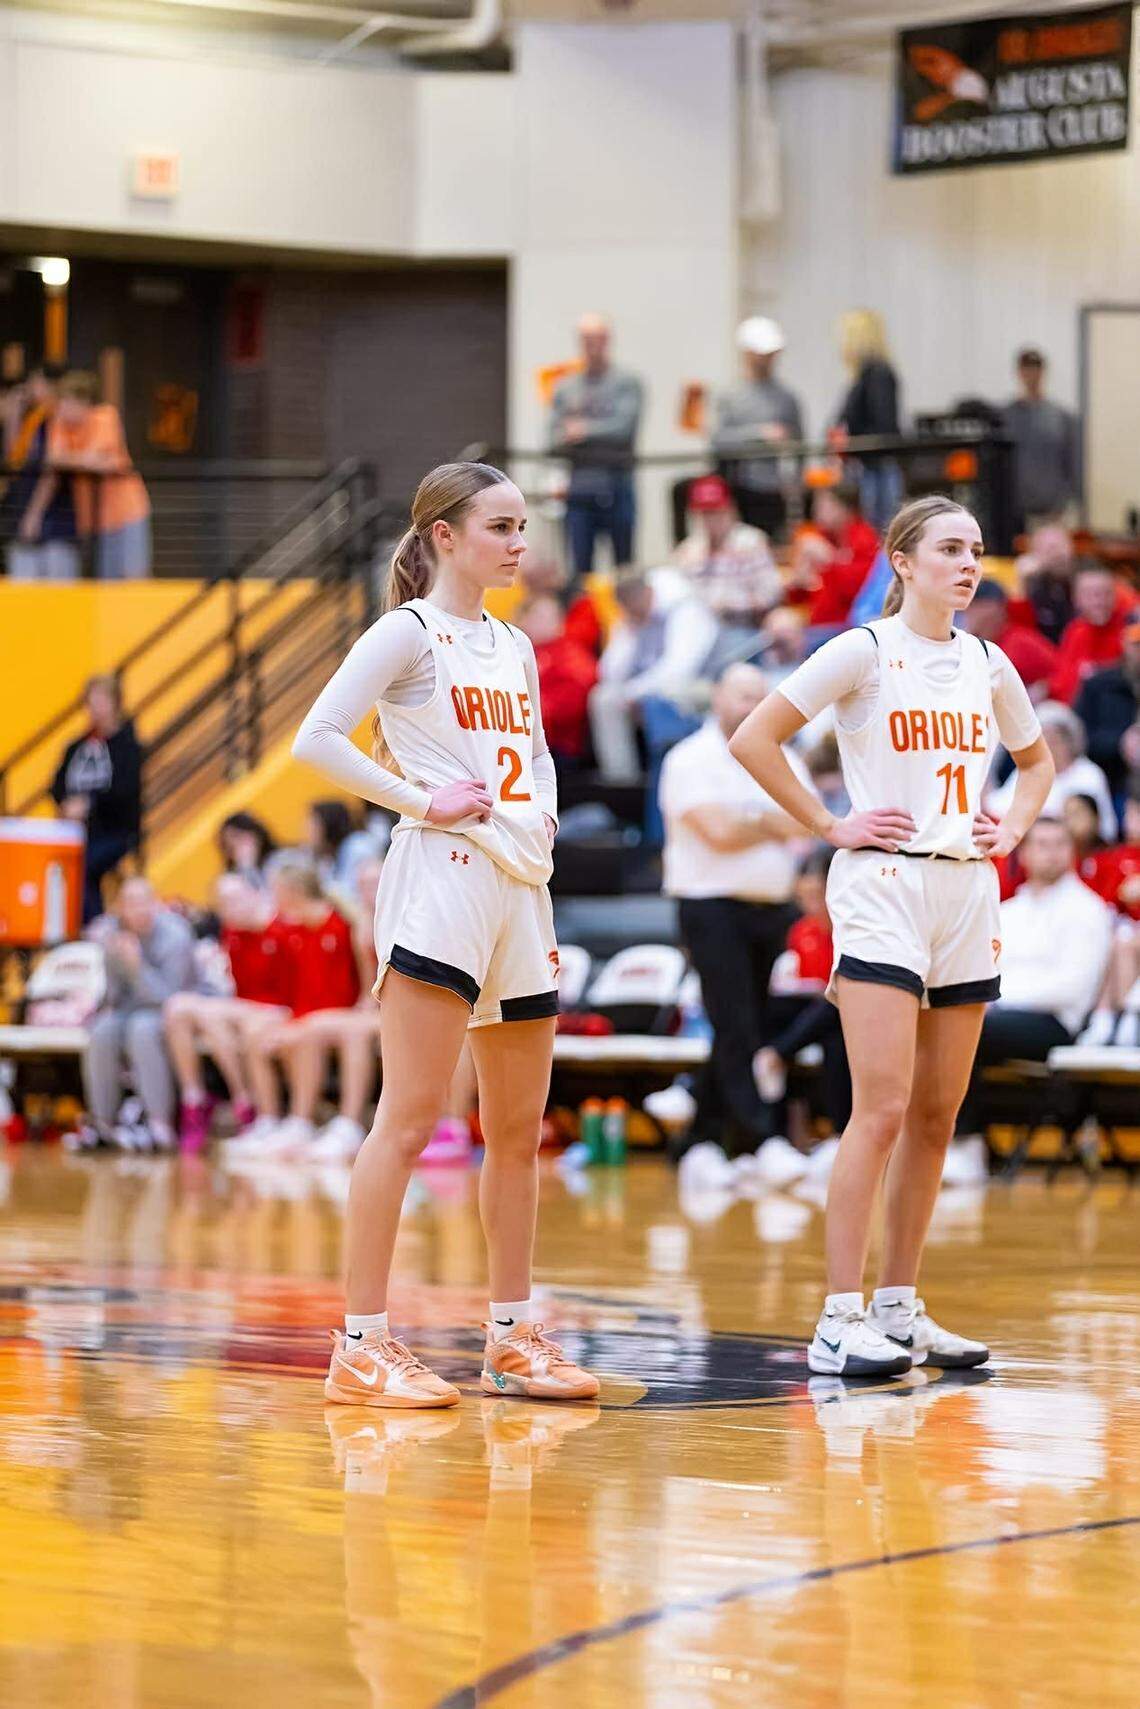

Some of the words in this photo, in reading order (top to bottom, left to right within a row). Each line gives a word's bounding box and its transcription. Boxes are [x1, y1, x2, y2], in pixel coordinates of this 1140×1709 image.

[889, 710, 990, 753] ORIOLE
[497, 746, 532, 801] 2
[936, 763, 969, 815] 11
